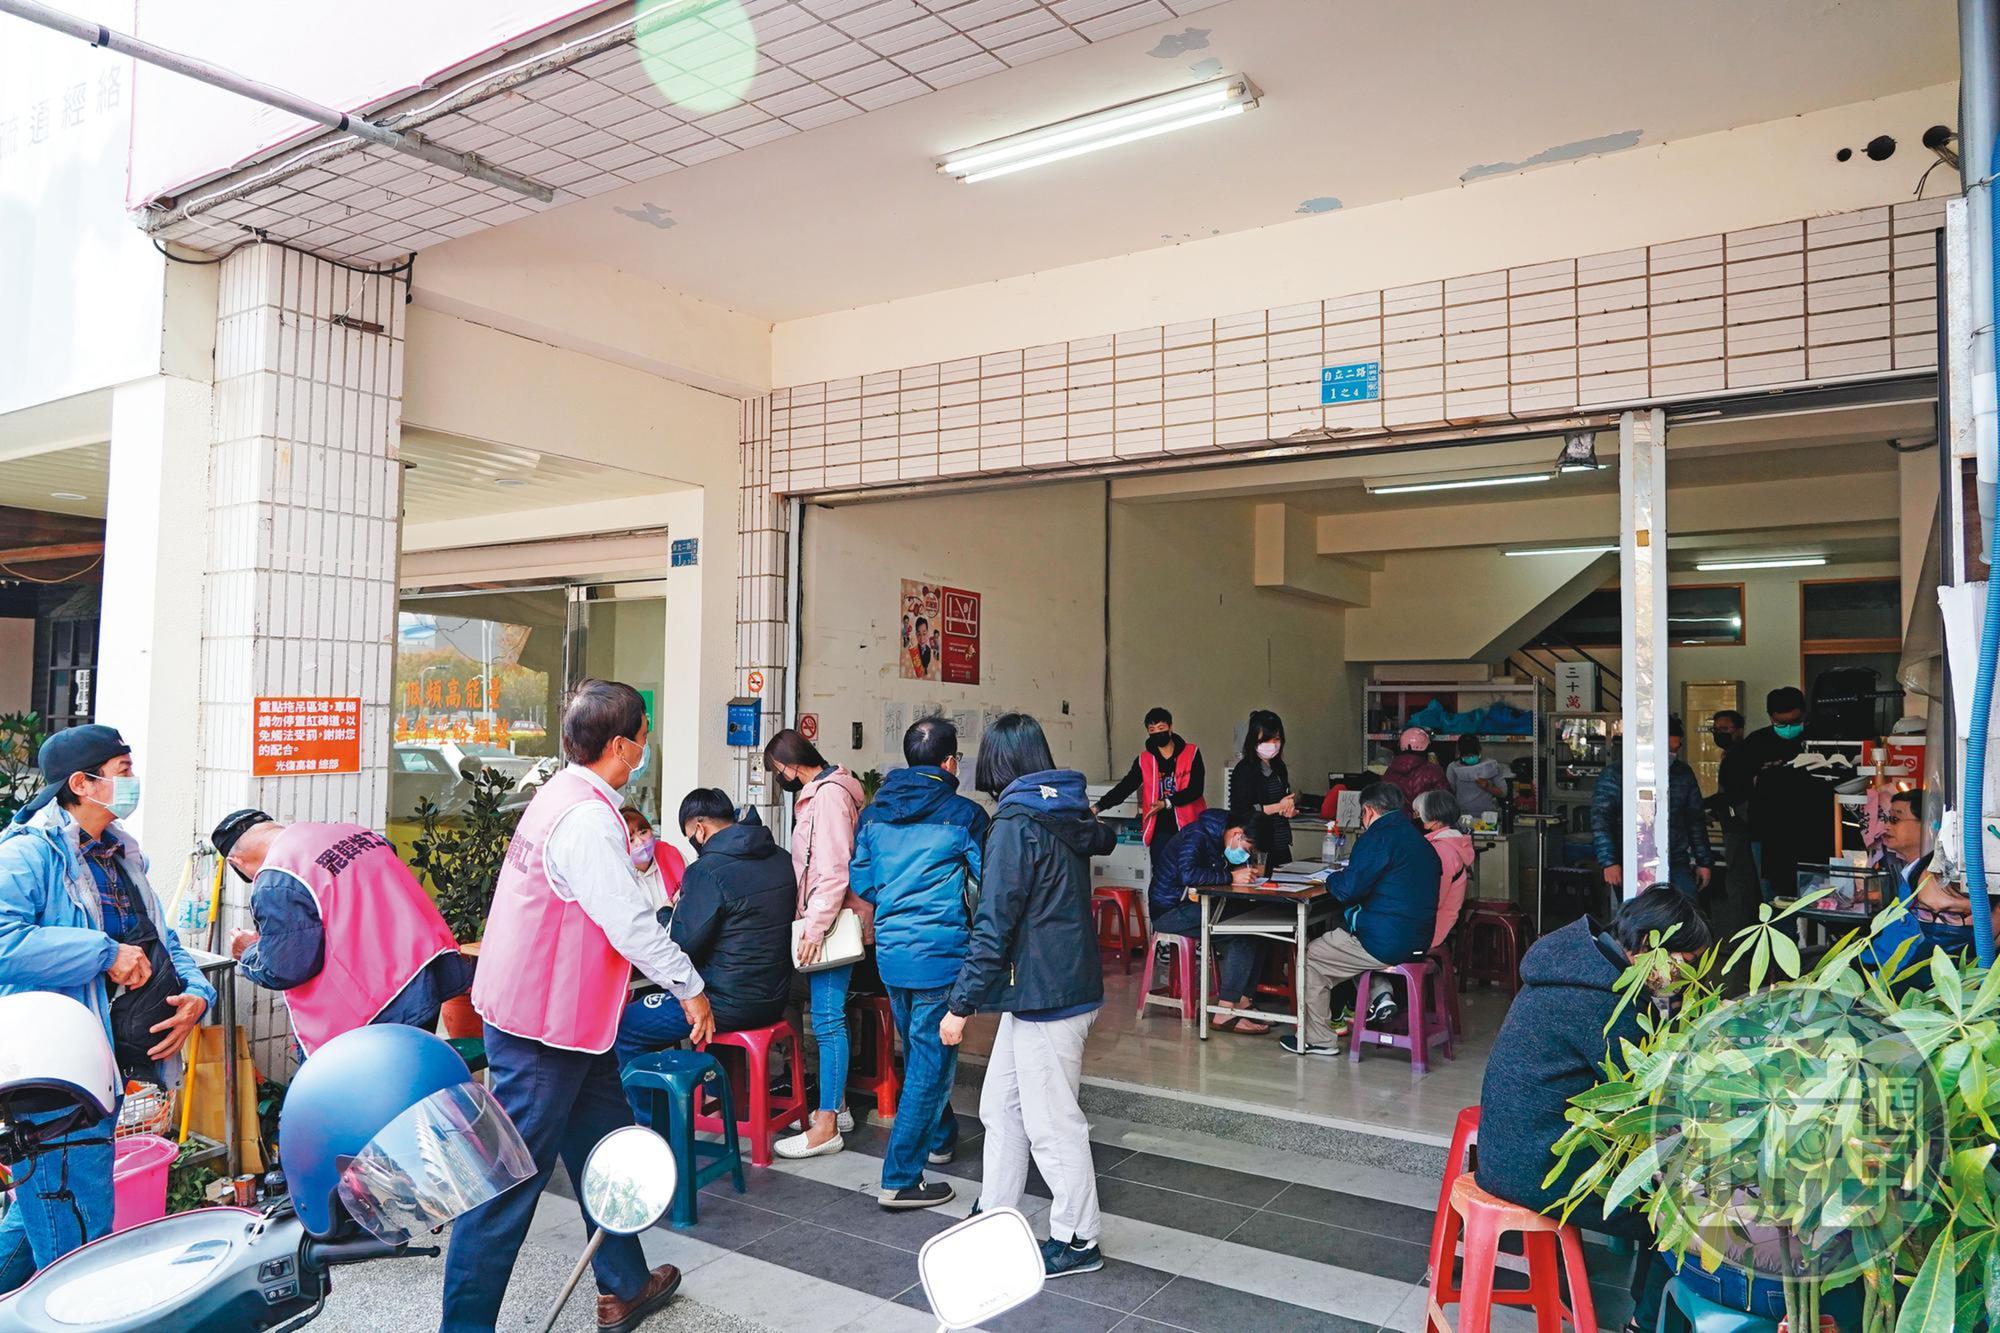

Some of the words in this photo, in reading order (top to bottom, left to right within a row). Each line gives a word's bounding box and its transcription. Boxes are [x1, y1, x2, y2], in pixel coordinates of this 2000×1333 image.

[1324, 366, 1367, 382] 自立二路
[1565, 667, 1581, 709] 三十萬
[258, 744, 300, 757] 的配合。
